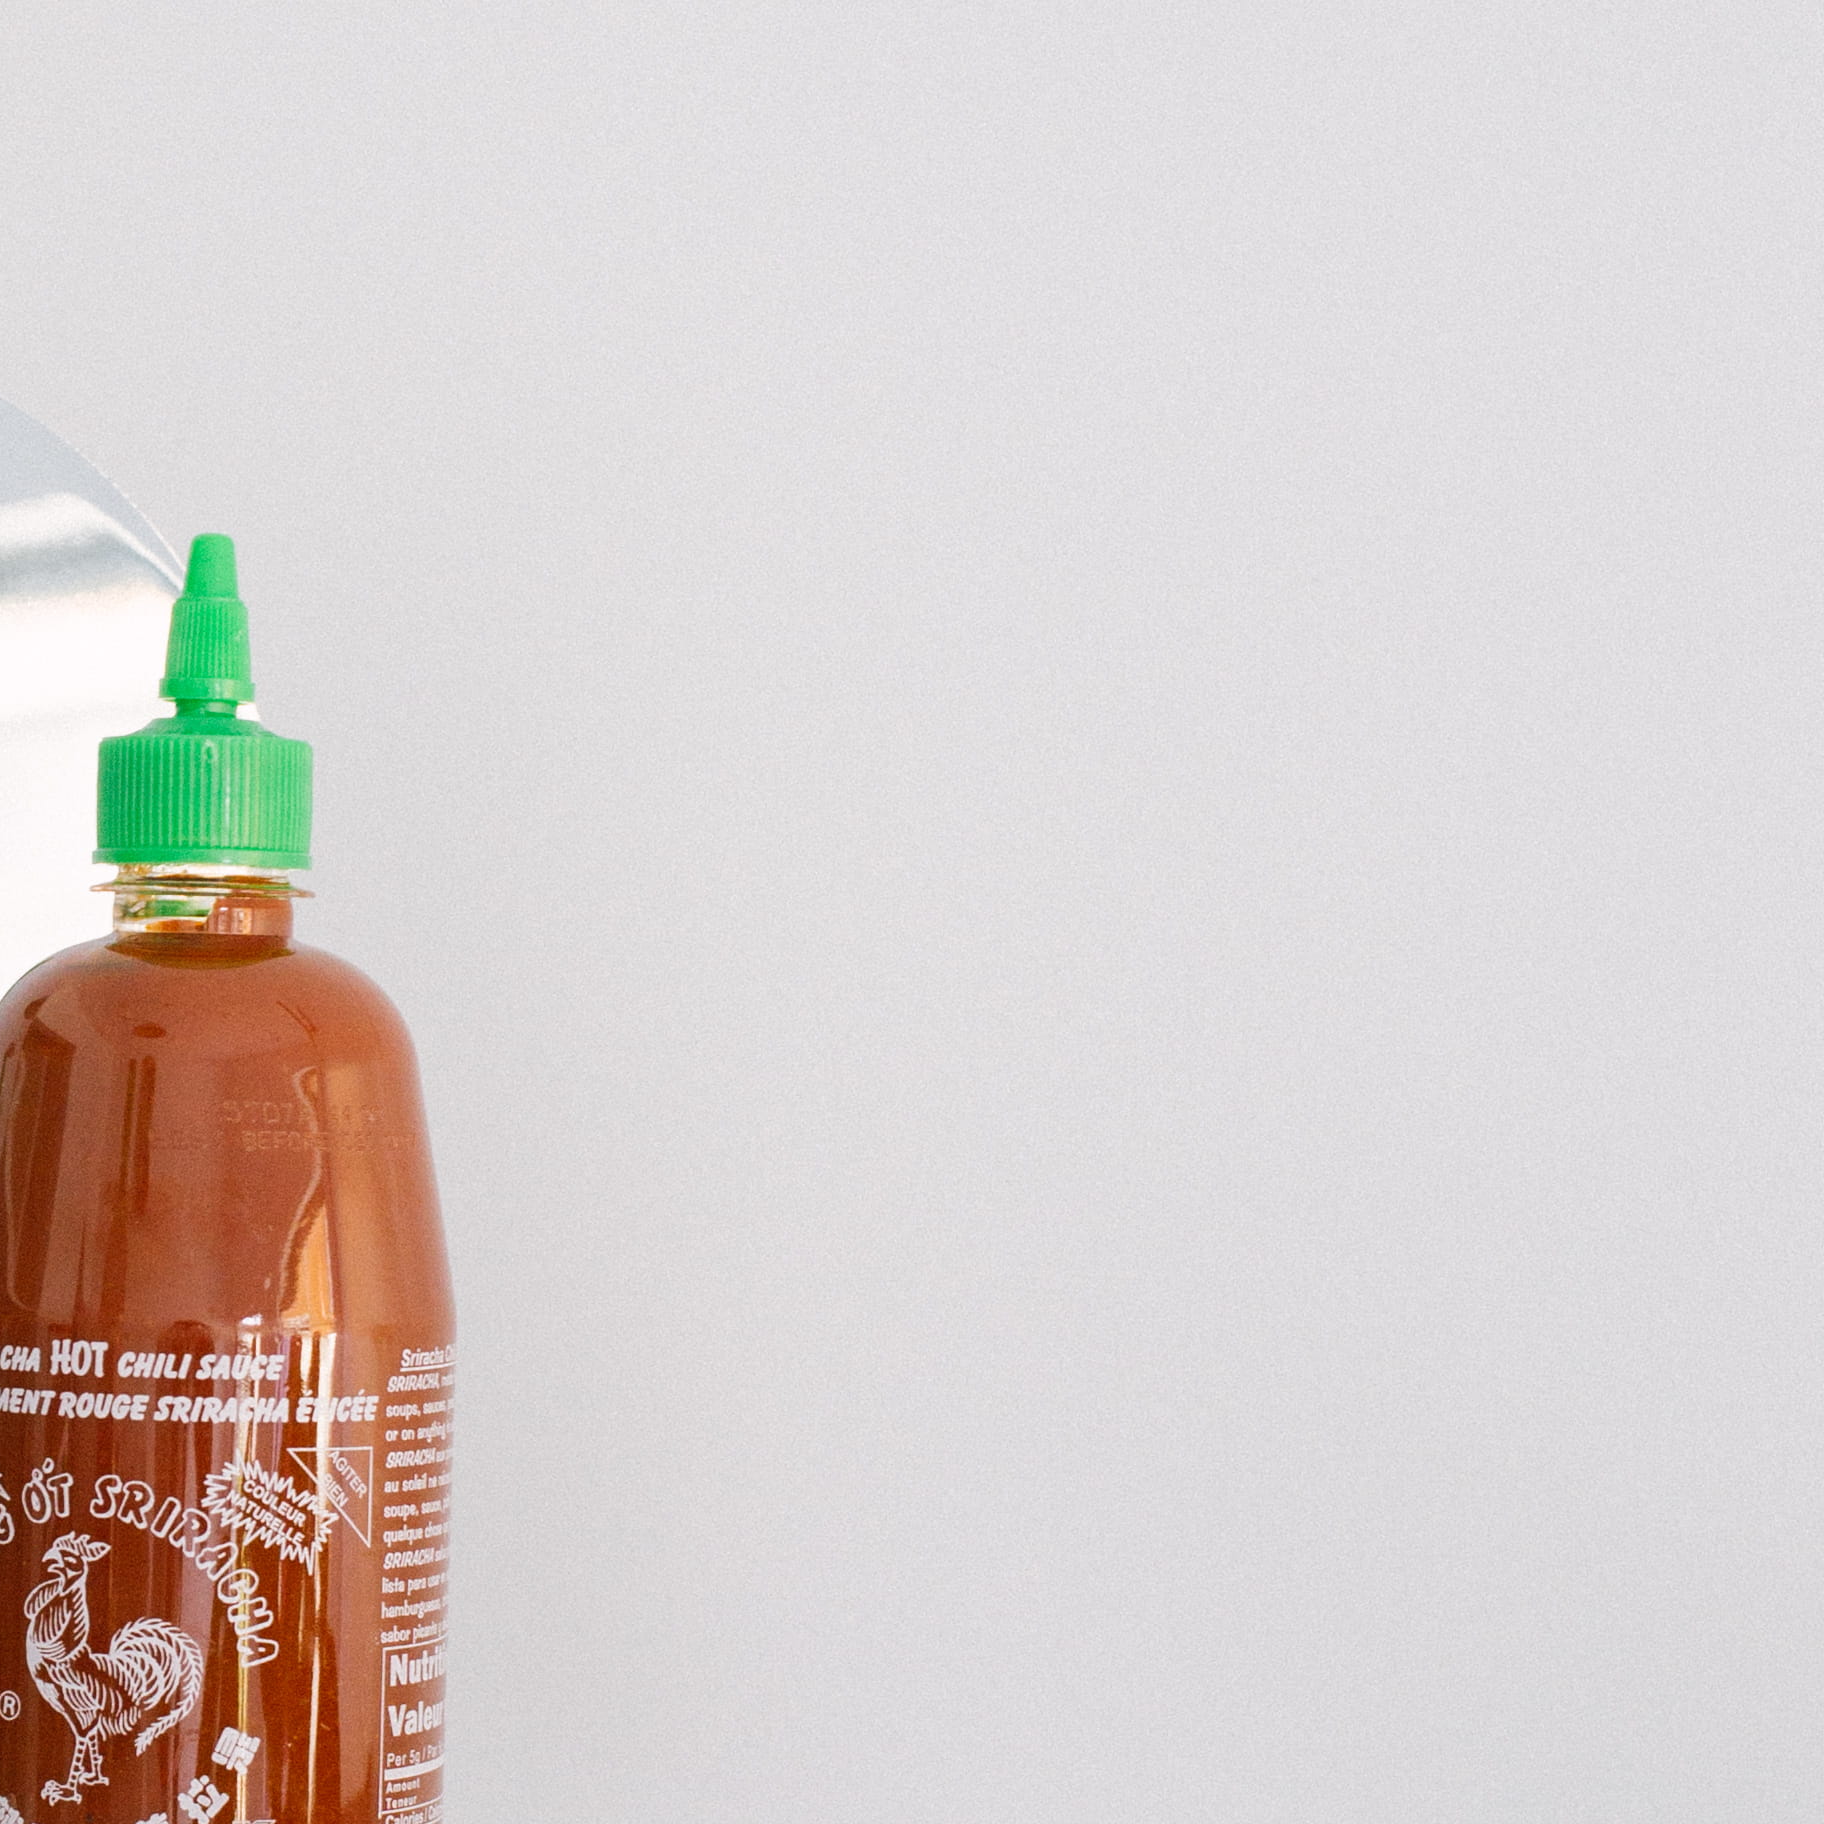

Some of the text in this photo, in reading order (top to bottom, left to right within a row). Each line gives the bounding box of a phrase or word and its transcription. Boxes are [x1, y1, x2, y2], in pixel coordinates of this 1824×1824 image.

[50, 1338, 110, 1378] HOT
[117, 1351, 192, 1380] CHILI
[195, 1354, 284, 1381] SAUCE
[387, 1373, 440, 1393] SRIRACHA
[58, 1391, 150, 1421] ROUGE
[152, 1395, 289, 1424] SRIRACHA
[328, 1450, 368, 1499] AGITER
[227, 1491, 304, 1546] NATURELLE
[243, 1480, 307, 1528] COULEUR
[89, 1474, 280, 1667] SRIRACHA
[386, 1752, 407, 1768] Per
[386, 1778, 420, 1794] Amount
[386, 1796, 417, 1809] Teneur
